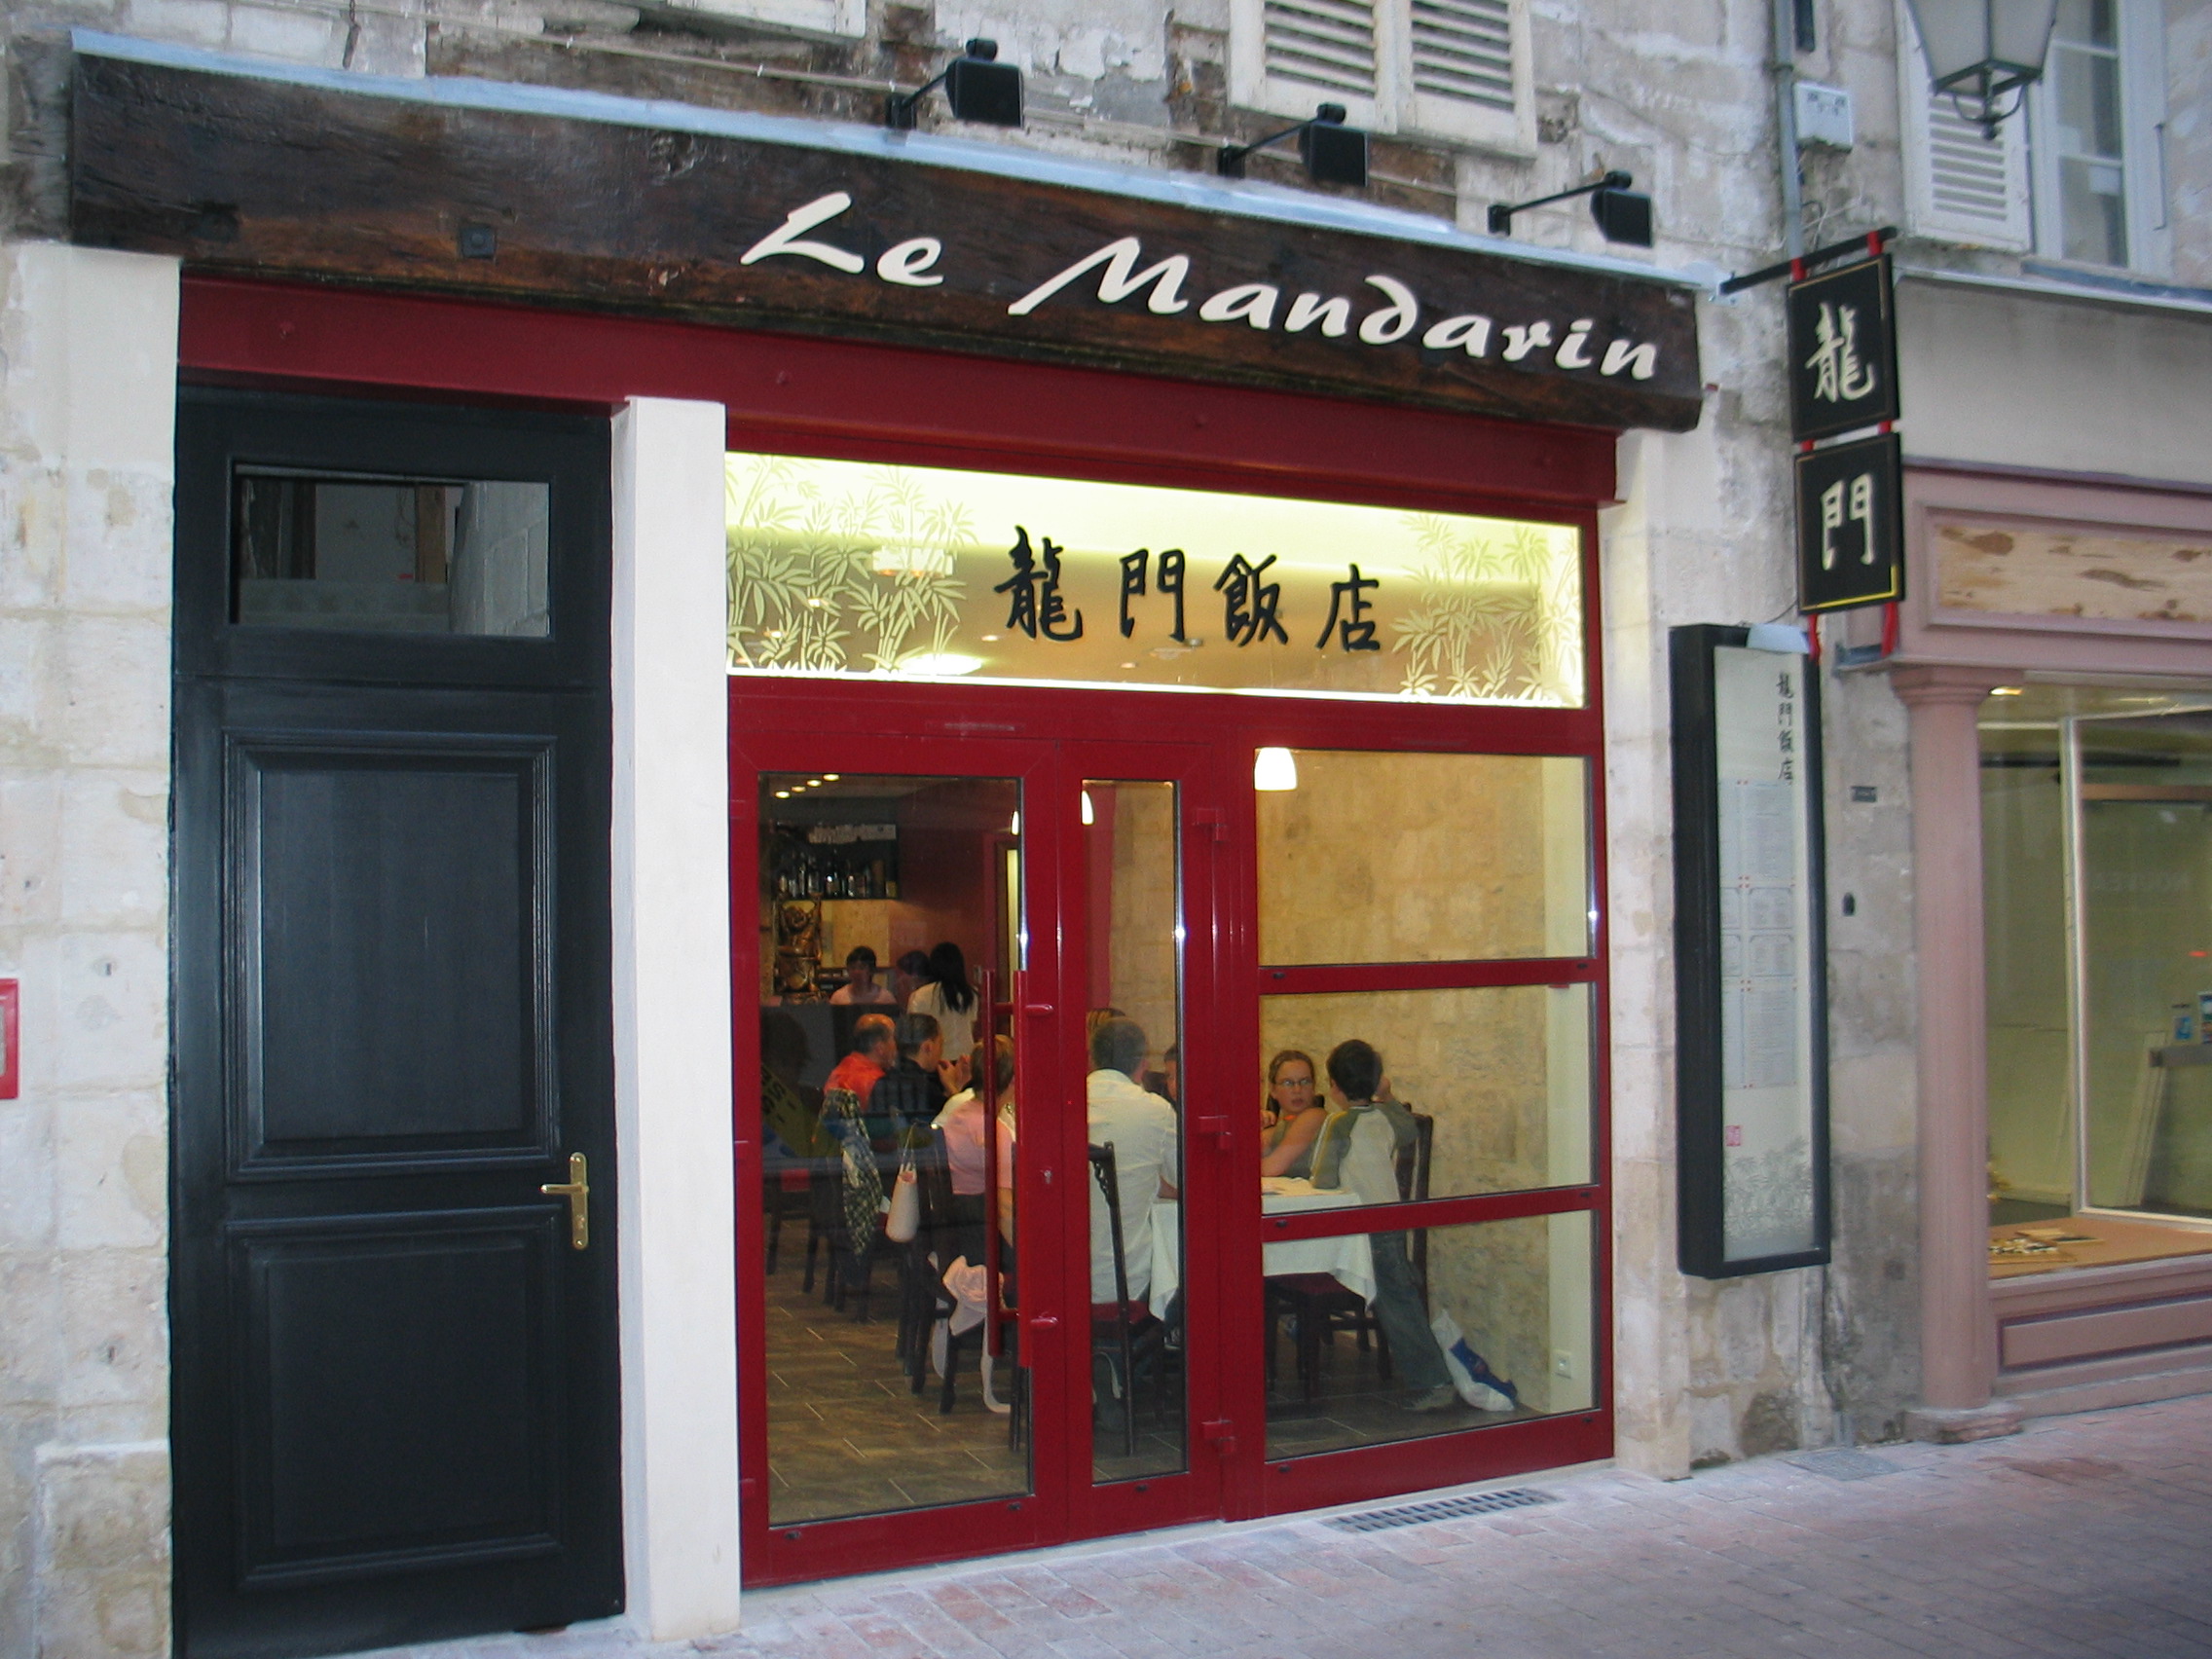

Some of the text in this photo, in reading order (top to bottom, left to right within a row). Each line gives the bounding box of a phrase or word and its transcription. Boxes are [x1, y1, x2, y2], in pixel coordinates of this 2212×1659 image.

[740, 192, 1657, 379] Le Mandarin
[1807, 304, 1875, 571] 龍門
[993, 526, 1382, 653] 龍門飯店
